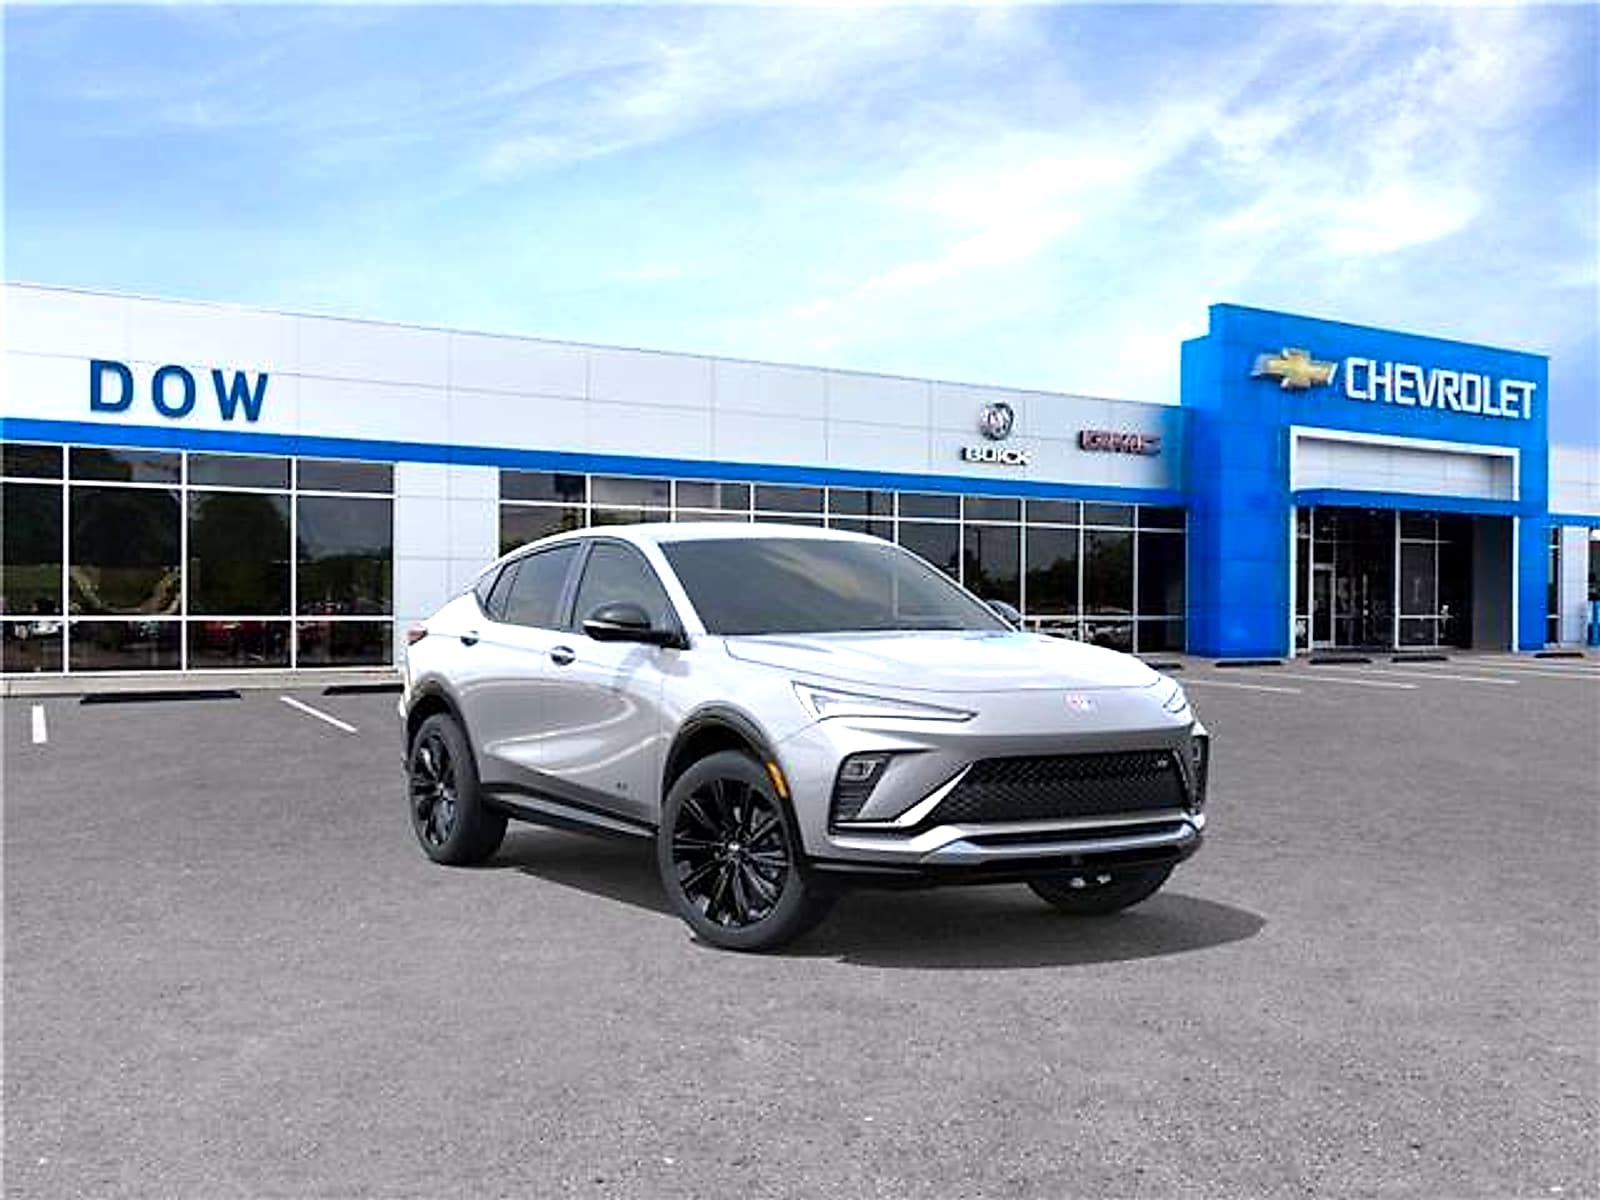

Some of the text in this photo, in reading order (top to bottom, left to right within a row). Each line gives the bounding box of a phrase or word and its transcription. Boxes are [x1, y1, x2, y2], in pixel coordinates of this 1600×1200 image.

[90, 359, 269, 422] DOW
[1346, 357, 1537, 420] CHEVROLET
[961, 446, 1032, 465] BUICK
